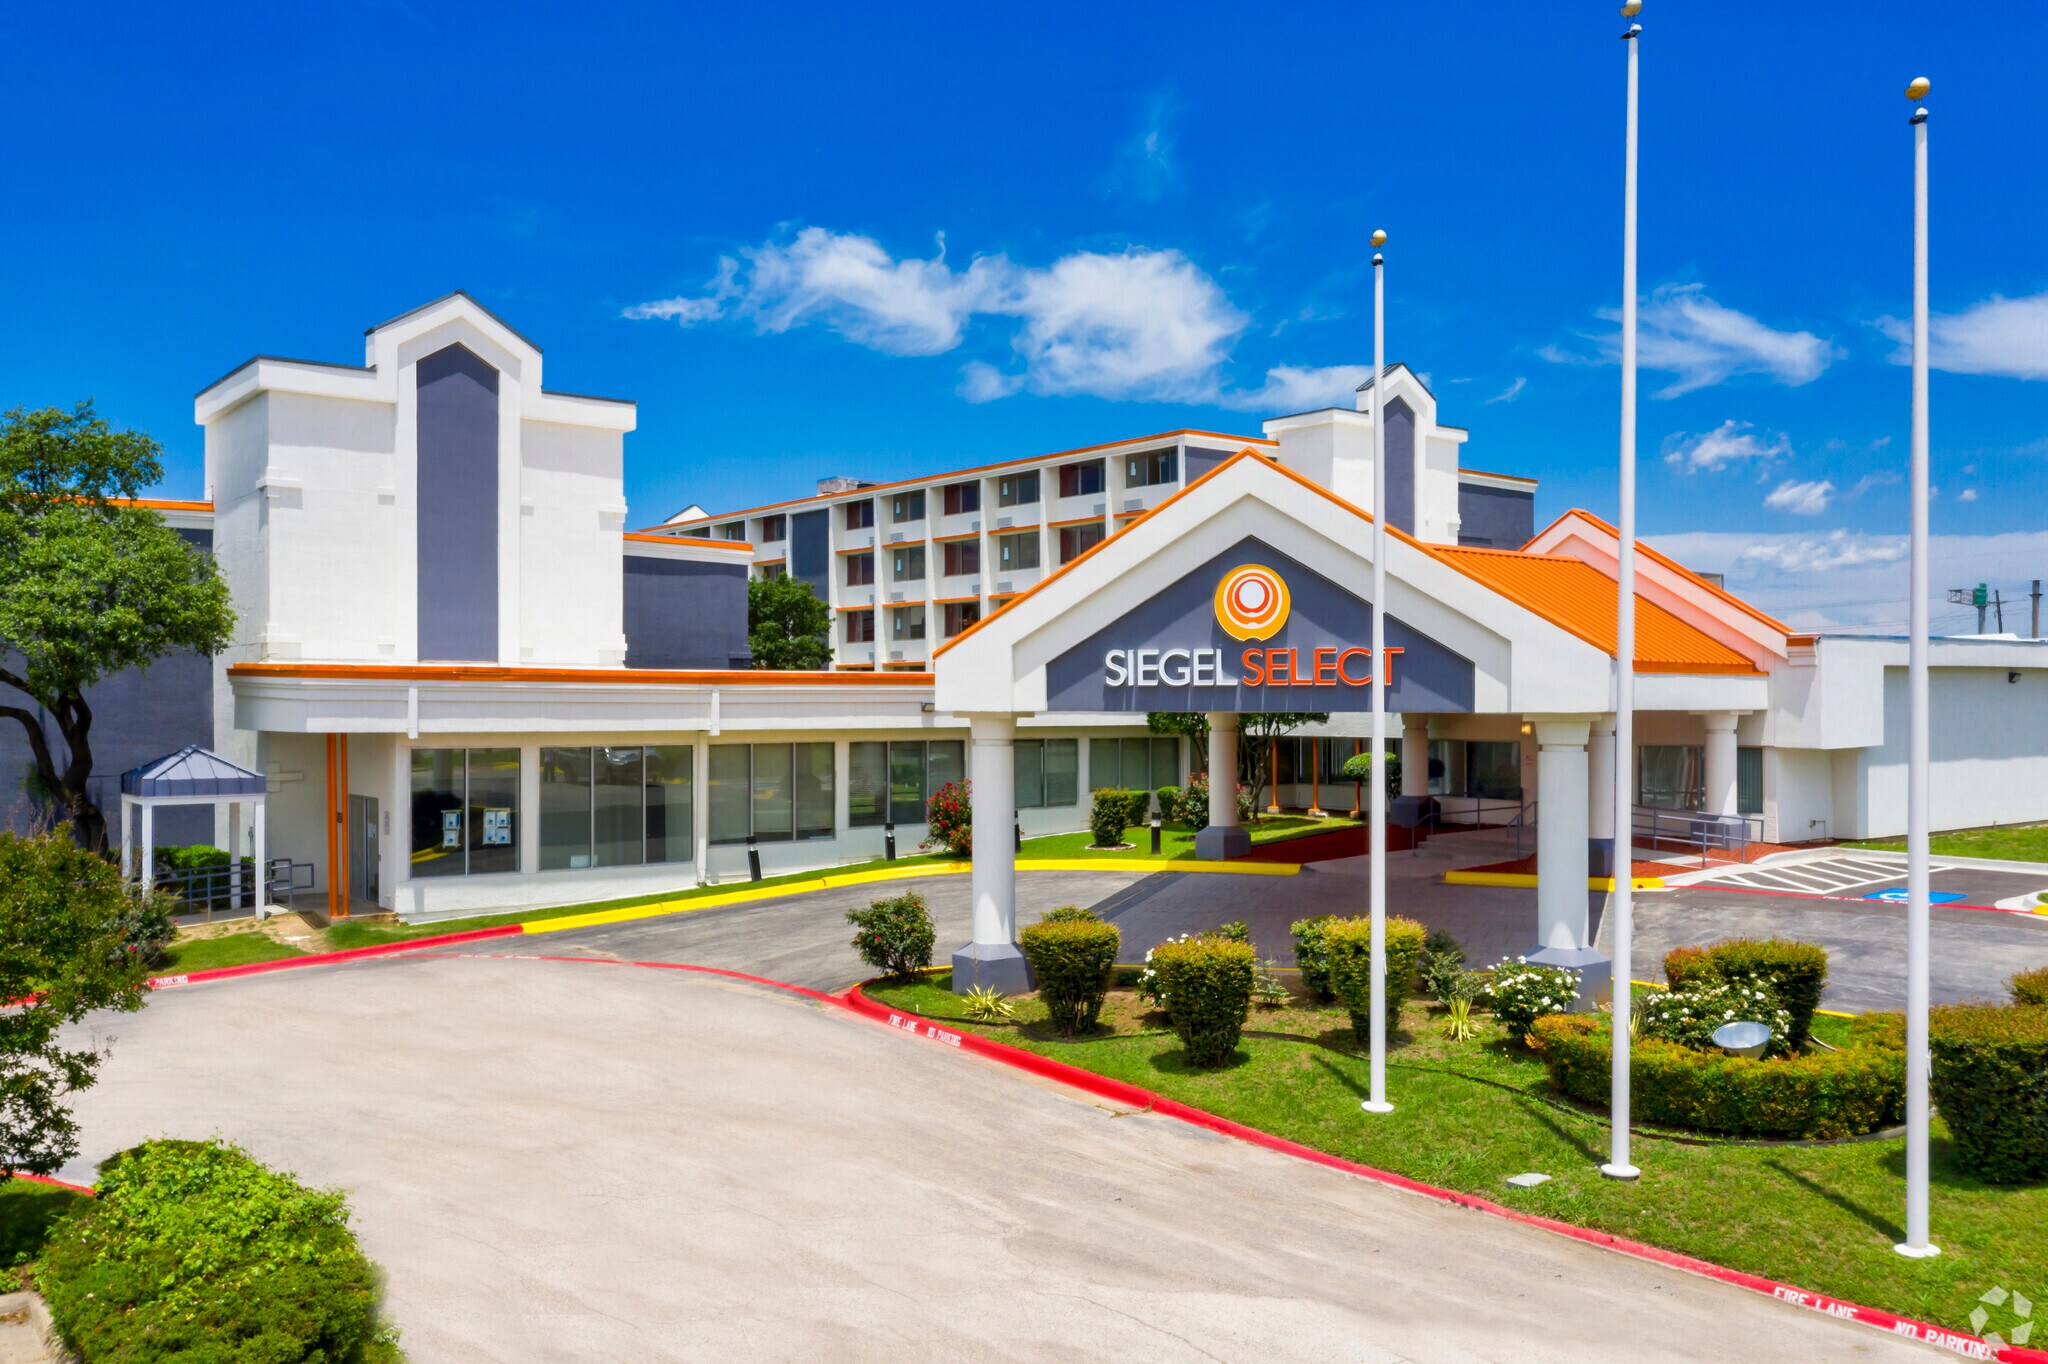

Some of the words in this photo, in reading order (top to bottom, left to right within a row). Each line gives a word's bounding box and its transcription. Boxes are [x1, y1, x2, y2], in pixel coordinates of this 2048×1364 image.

[1104, 648, 1238, 686] SIEGEL
[1241, 647, 1405, 686] SELECT
[888, 1014, 902, 1027] FIRE
[902, 1019, 917, 1032] LANE
[927, 1027, 936, 1038] NO
[936, 1030, 961, 1046] PARKING
[1774, 1286, 1809, 1306] FIRE
[1816, 1299, 1858, 1320] LANE
[1895, 1320, 1917, 1338] NO
